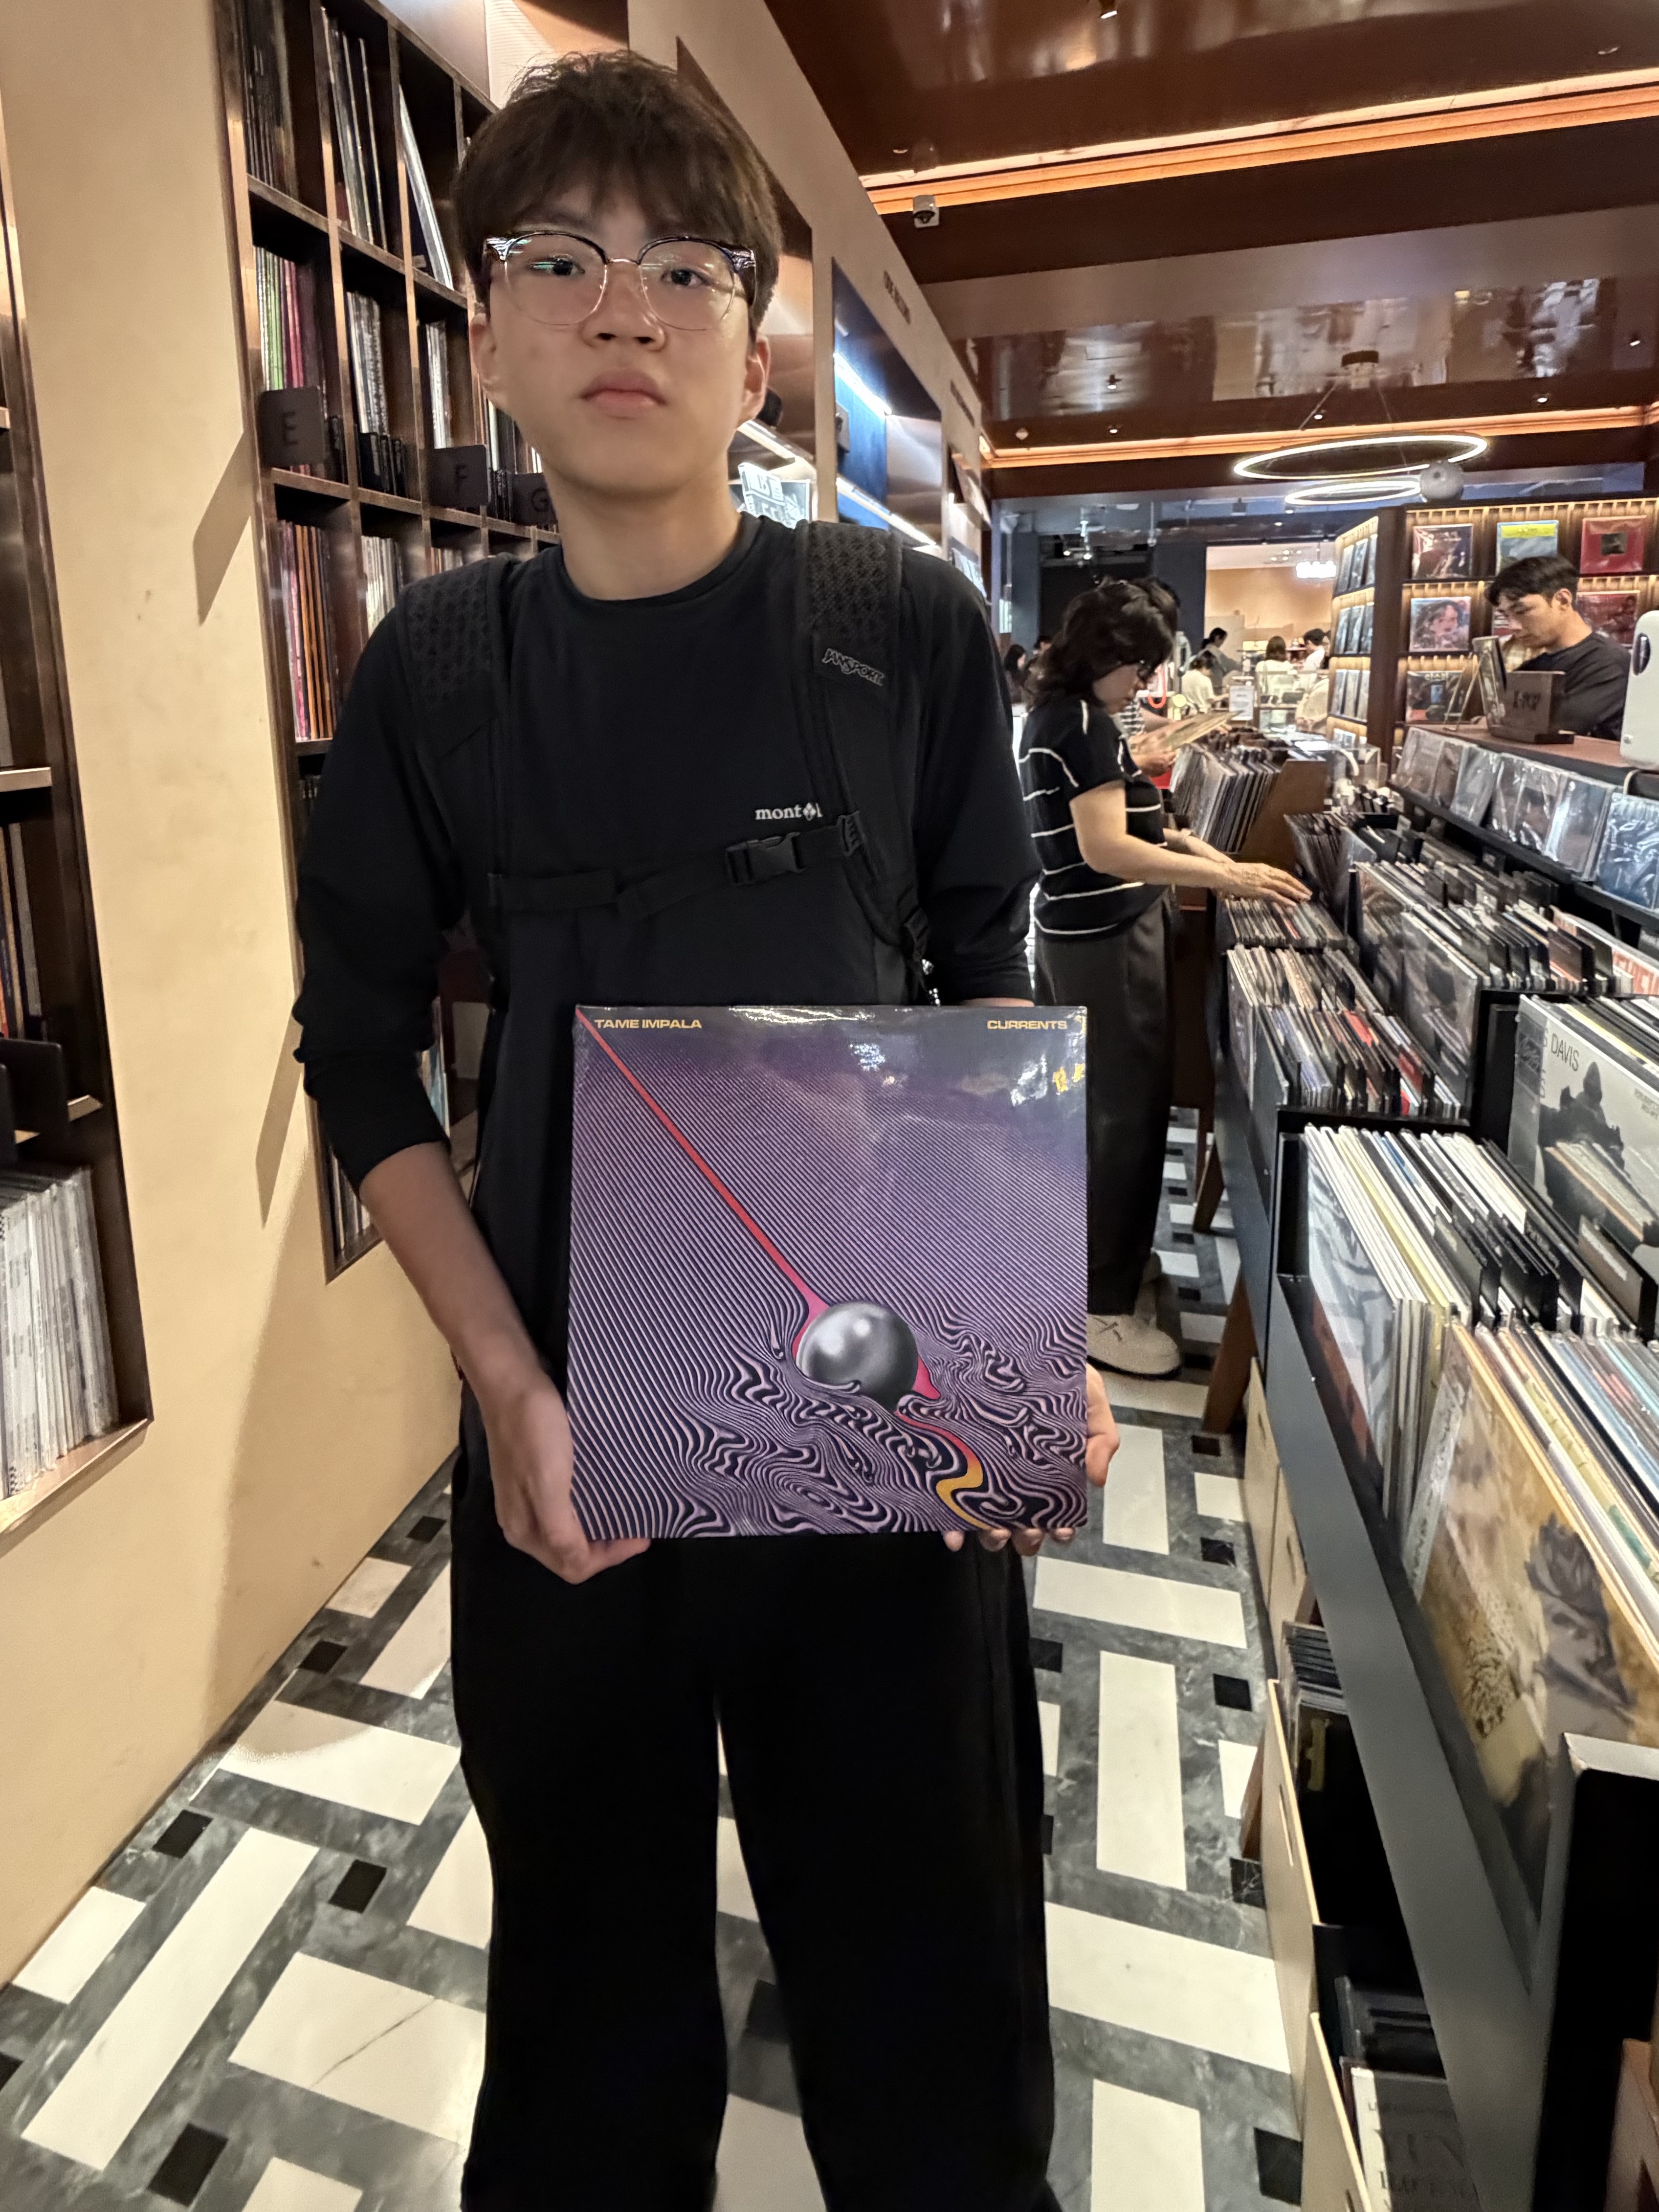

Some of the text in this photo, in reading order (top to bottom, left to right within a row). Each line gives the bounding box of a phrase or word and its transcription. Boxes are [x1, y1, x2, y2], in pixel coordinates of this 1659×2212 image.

[282, 411, 299, 446] E
[454, 463, 468, 492] F
[531, 487, 550, 513] G
[595, 1019, 702, 1029] TAME IMPALA
[987, 1020, 1068, 1030] CURRENTS
[1550, 1032, 1580, 1072] DAVIS
